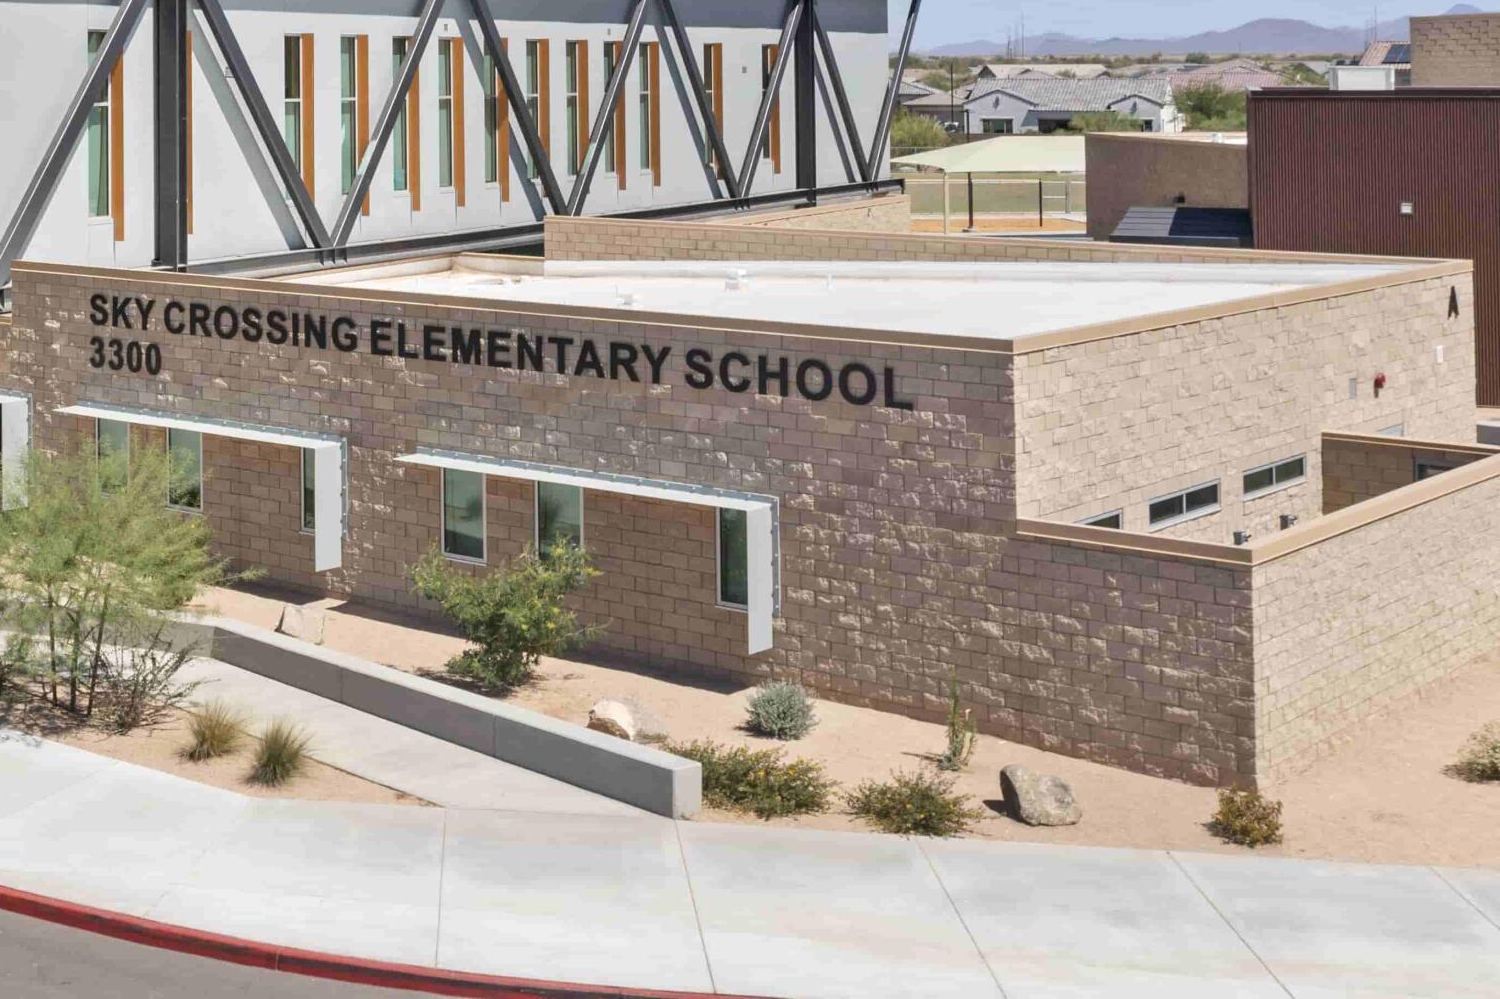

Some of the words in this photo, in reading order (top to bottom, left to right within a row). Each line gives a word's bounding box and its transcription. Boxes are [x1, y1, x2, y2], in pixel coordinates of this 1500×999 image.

[1447, 285, 1460, 320] A
[89, 293, 156, 331] SKY
[163, 301, 358, 353] CROSSING
[370, 319, 672, 384] ELEMENTARY
[684, 348, 913, 411] SCHOOL
[89, 336, 162, 376] 3300
